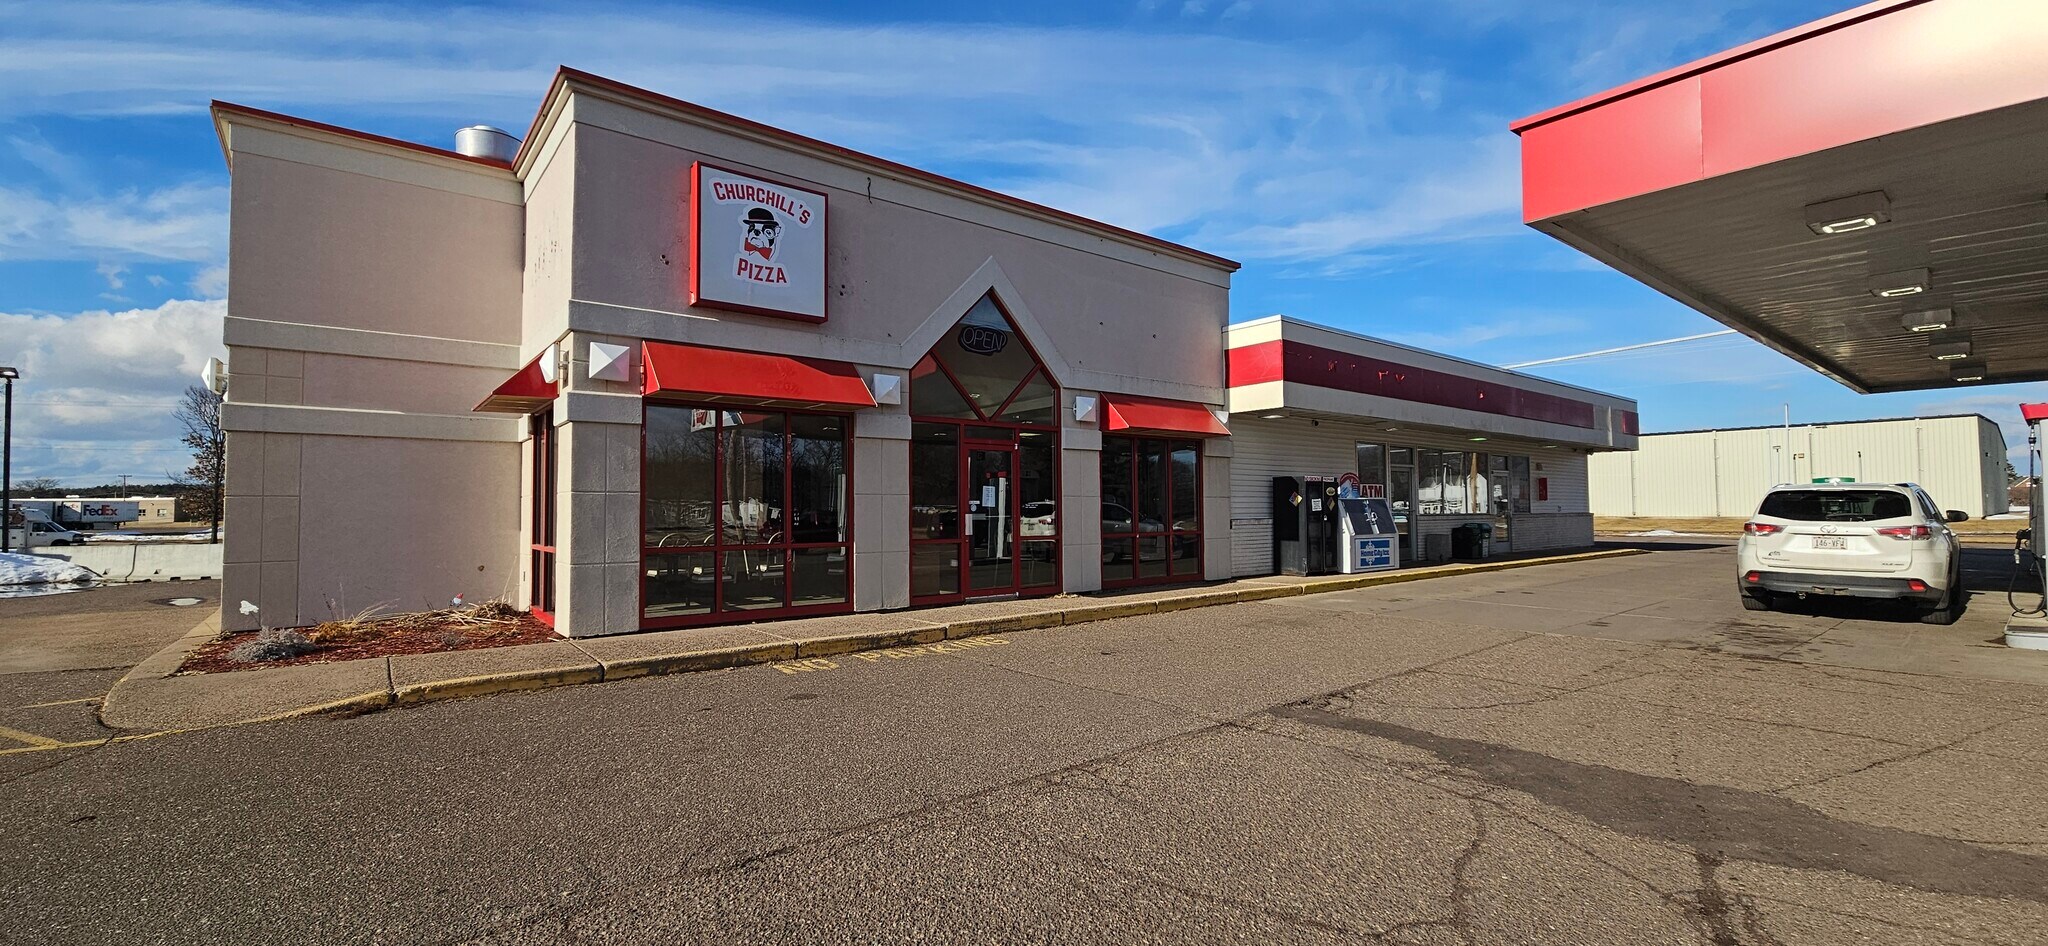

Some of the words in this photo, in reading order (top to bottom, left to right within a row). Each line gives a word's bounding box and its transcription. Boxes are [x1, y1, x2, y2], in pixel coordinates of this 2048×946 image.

[713, 182, 811, 225] CHURCHILL'S
[737, 258, 788, 284] PIZZA
[963, 327, 1003, 350] OPEN
[1361, 485, 1383, 498] ATM
[83, 504, 118, 517] FedEx
[772, 658, 840, 675] NO
[851, 636, 1012, 663] PARKING
